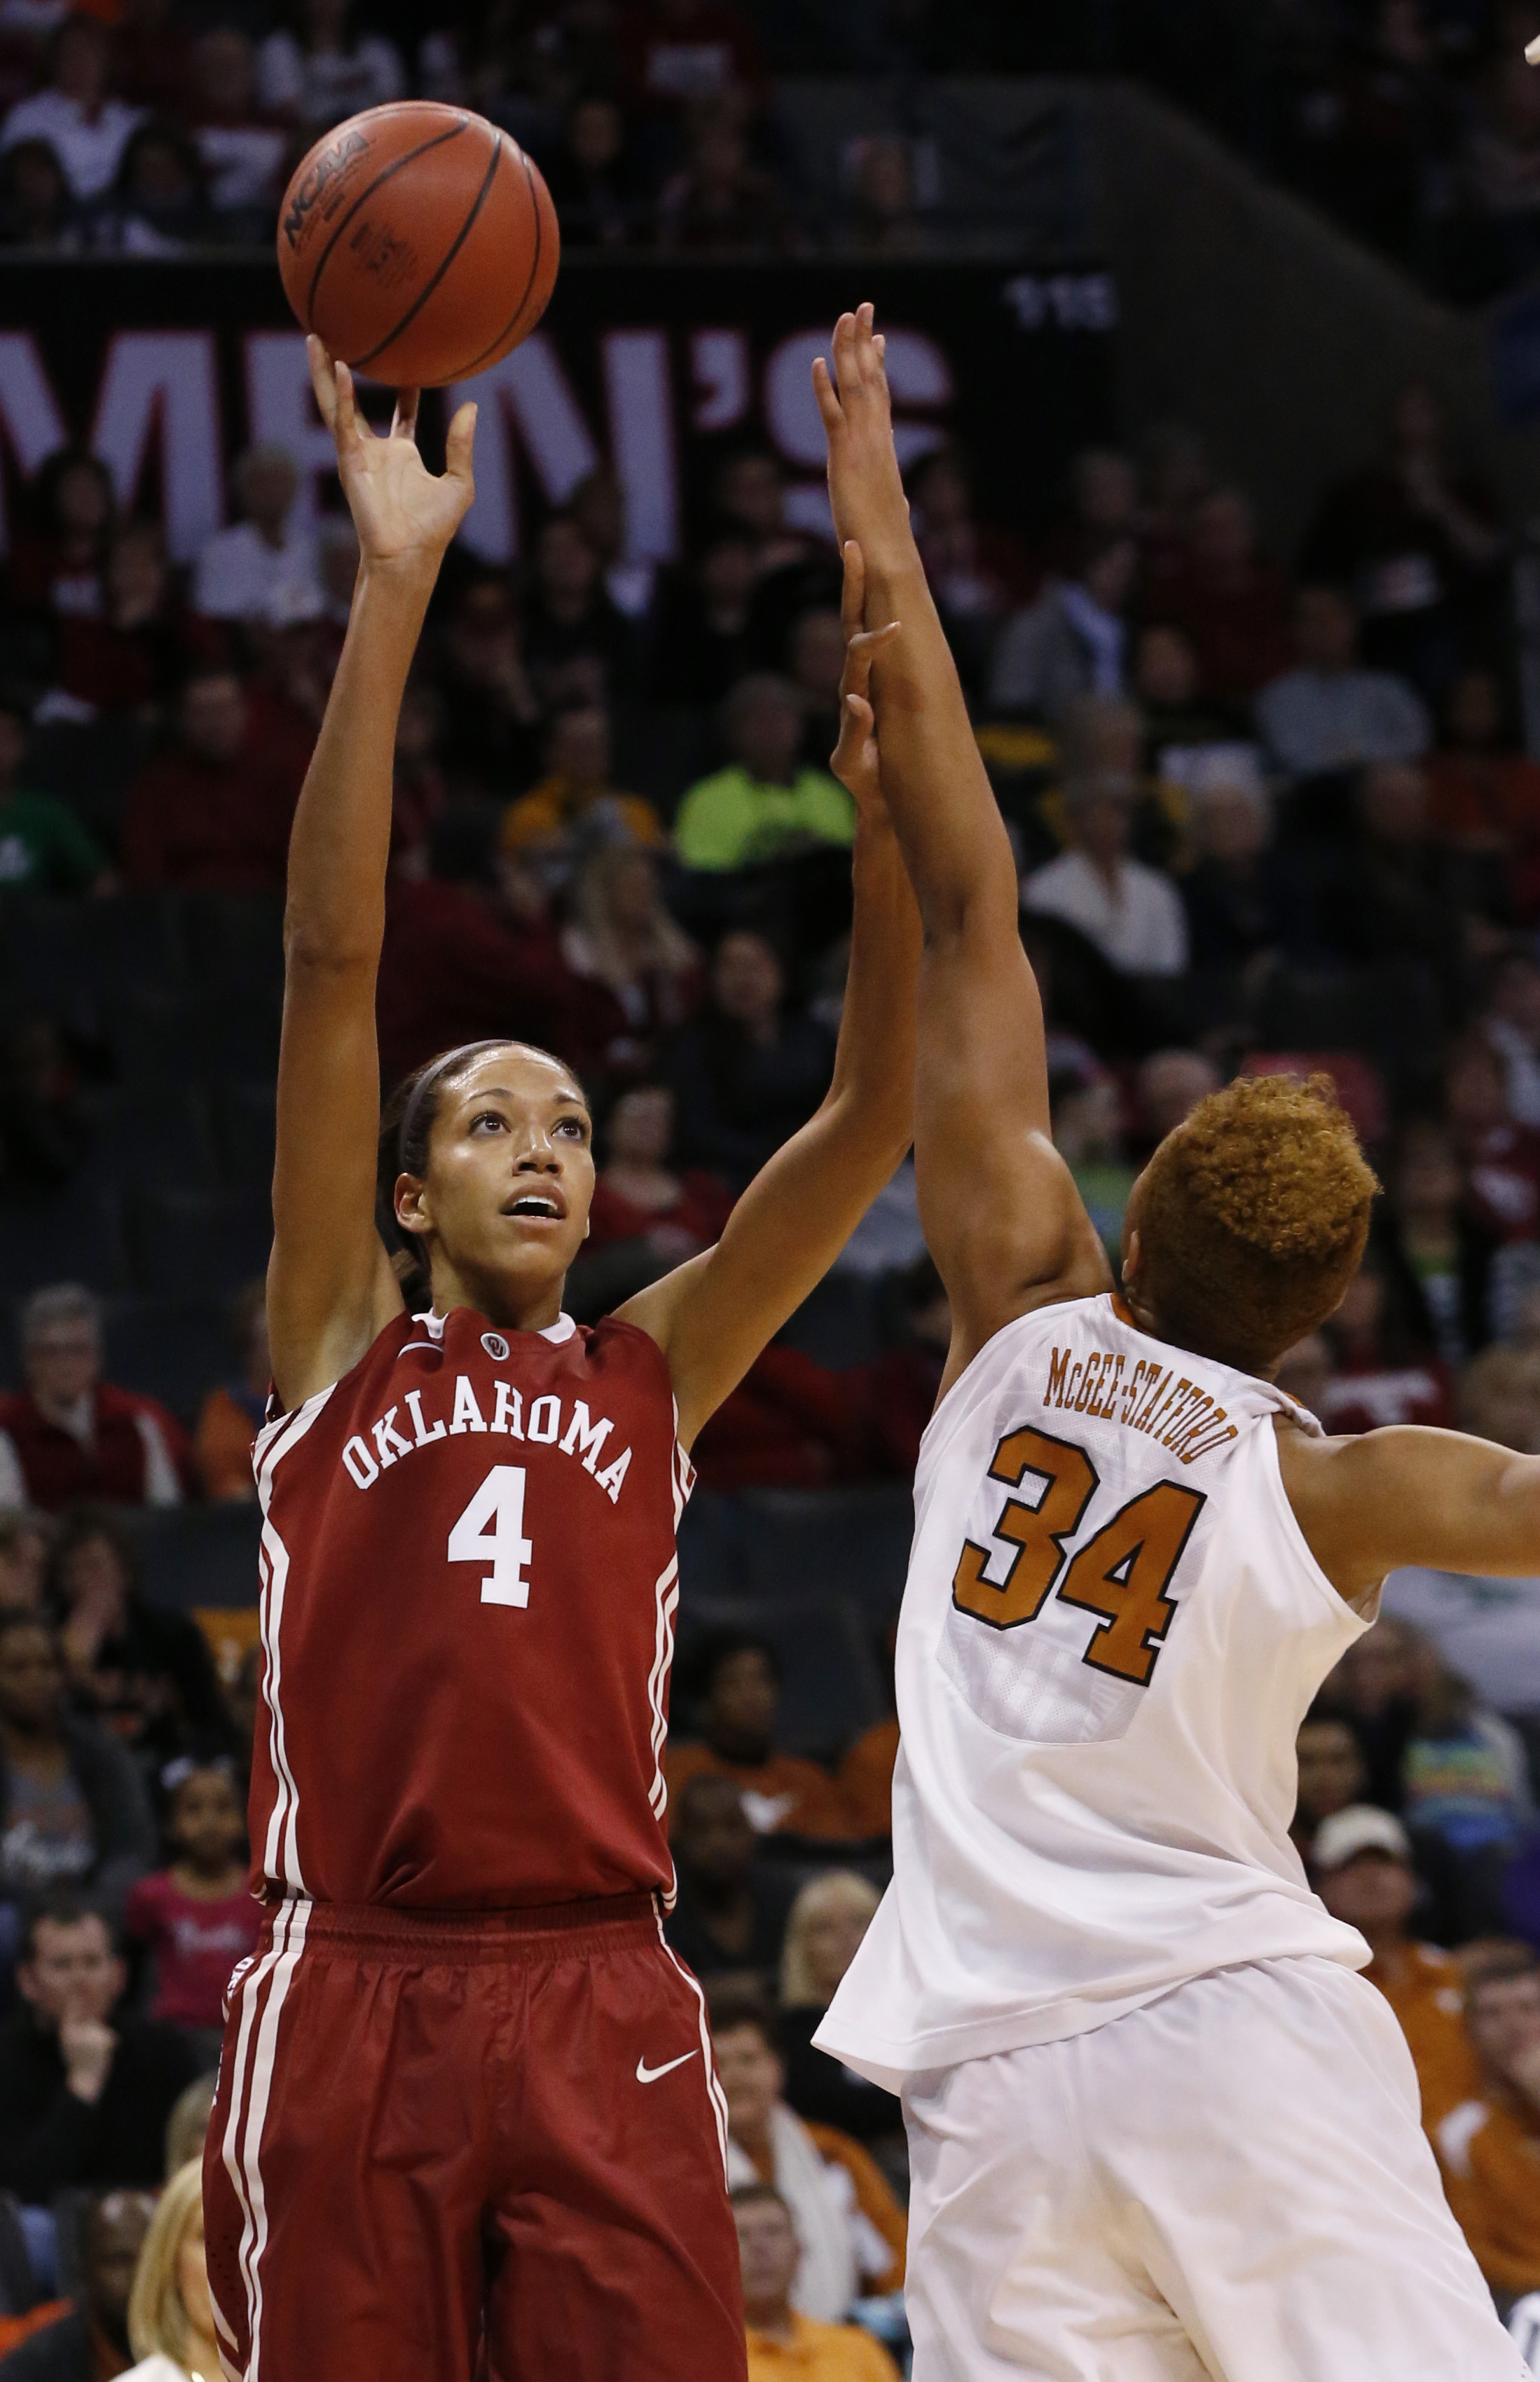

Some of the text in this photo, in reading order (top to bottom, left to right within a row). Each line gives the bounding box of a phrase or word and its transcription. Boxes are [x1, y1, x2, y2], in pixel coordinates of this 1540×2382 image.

[342, 1375, 632, 1505] OKLAHOMA
[1043, 1346, 1239, 1465] McGEE-STAFFORD
[447, 1465, 533, 1608] 4
[952, 1425, 1208, 1687] 34
